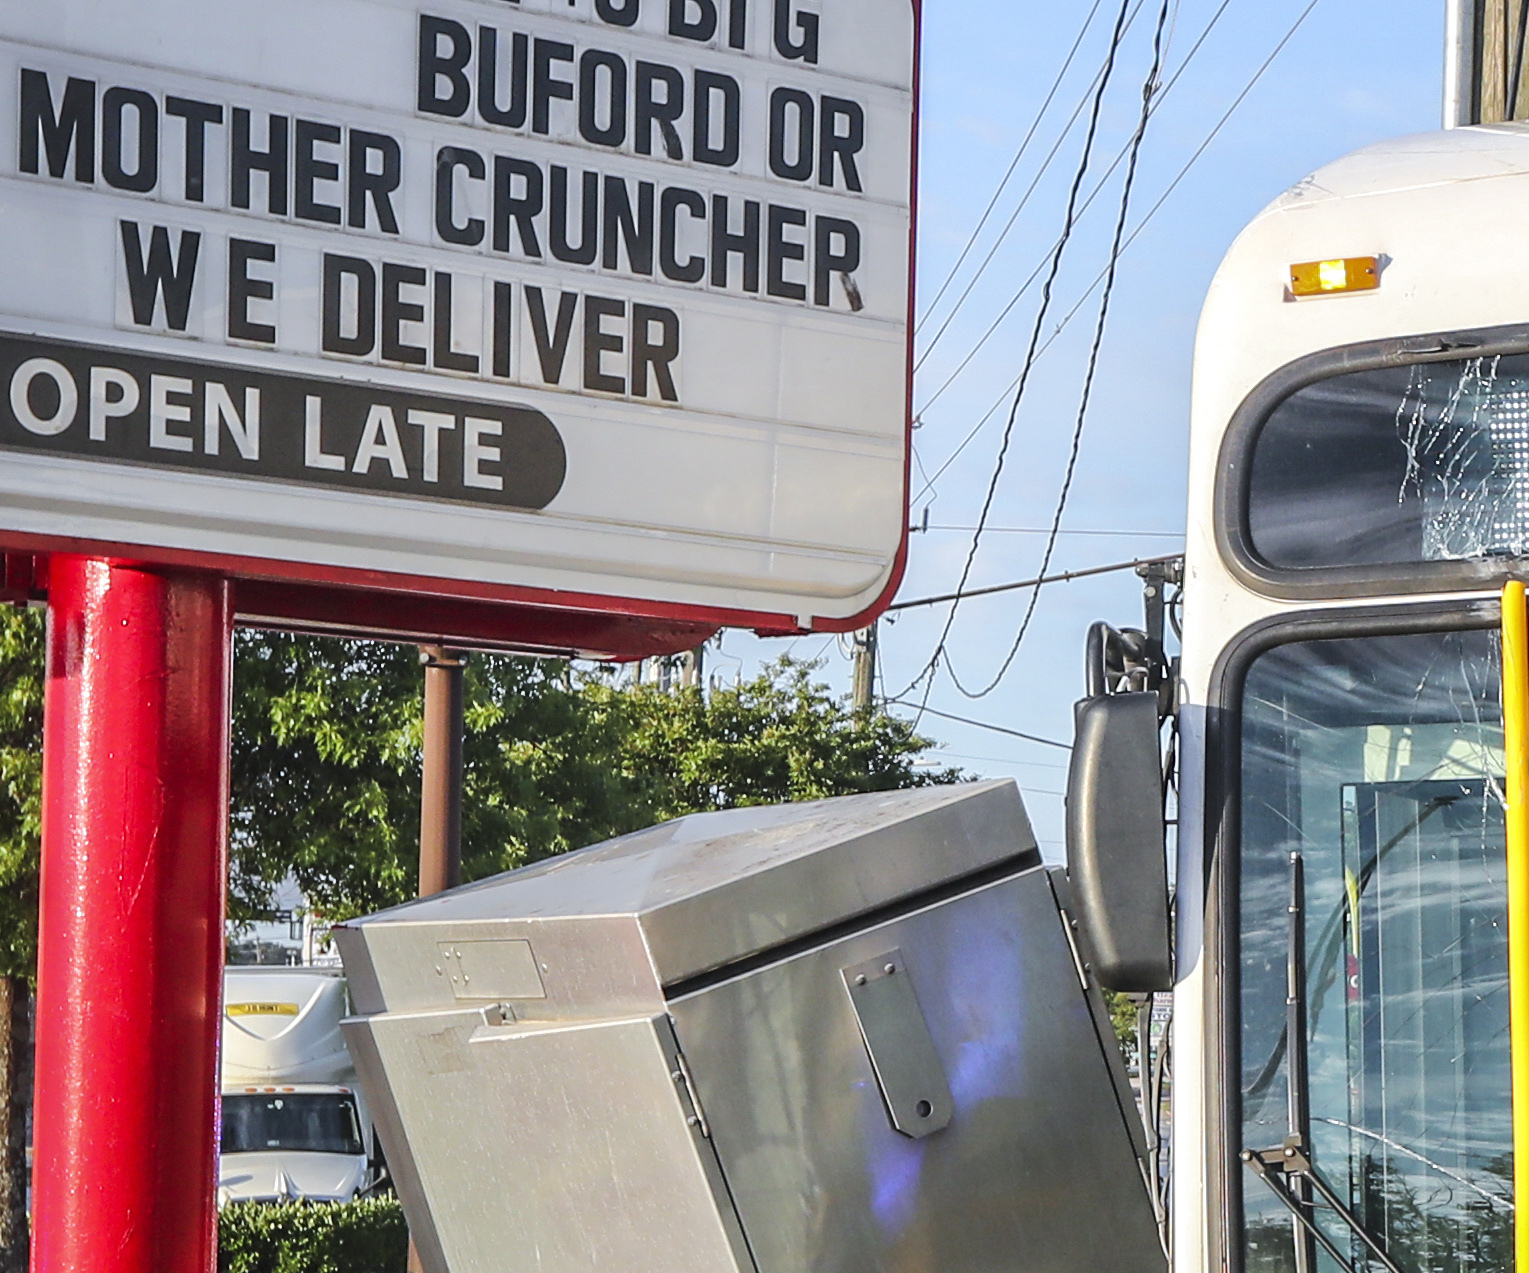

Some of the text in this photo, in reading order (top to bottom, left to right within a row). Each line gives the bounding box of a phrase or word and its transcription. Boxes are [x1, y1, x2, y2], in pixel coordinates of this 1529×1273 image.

[19, 68, 862, 312] MOTHER CRUNCHER
[417, 14, 865, 193] BUFORD OR
[119, 219, 680, 402] WE DELIVER
[10, 357, 505, 492] OPEN LATE
